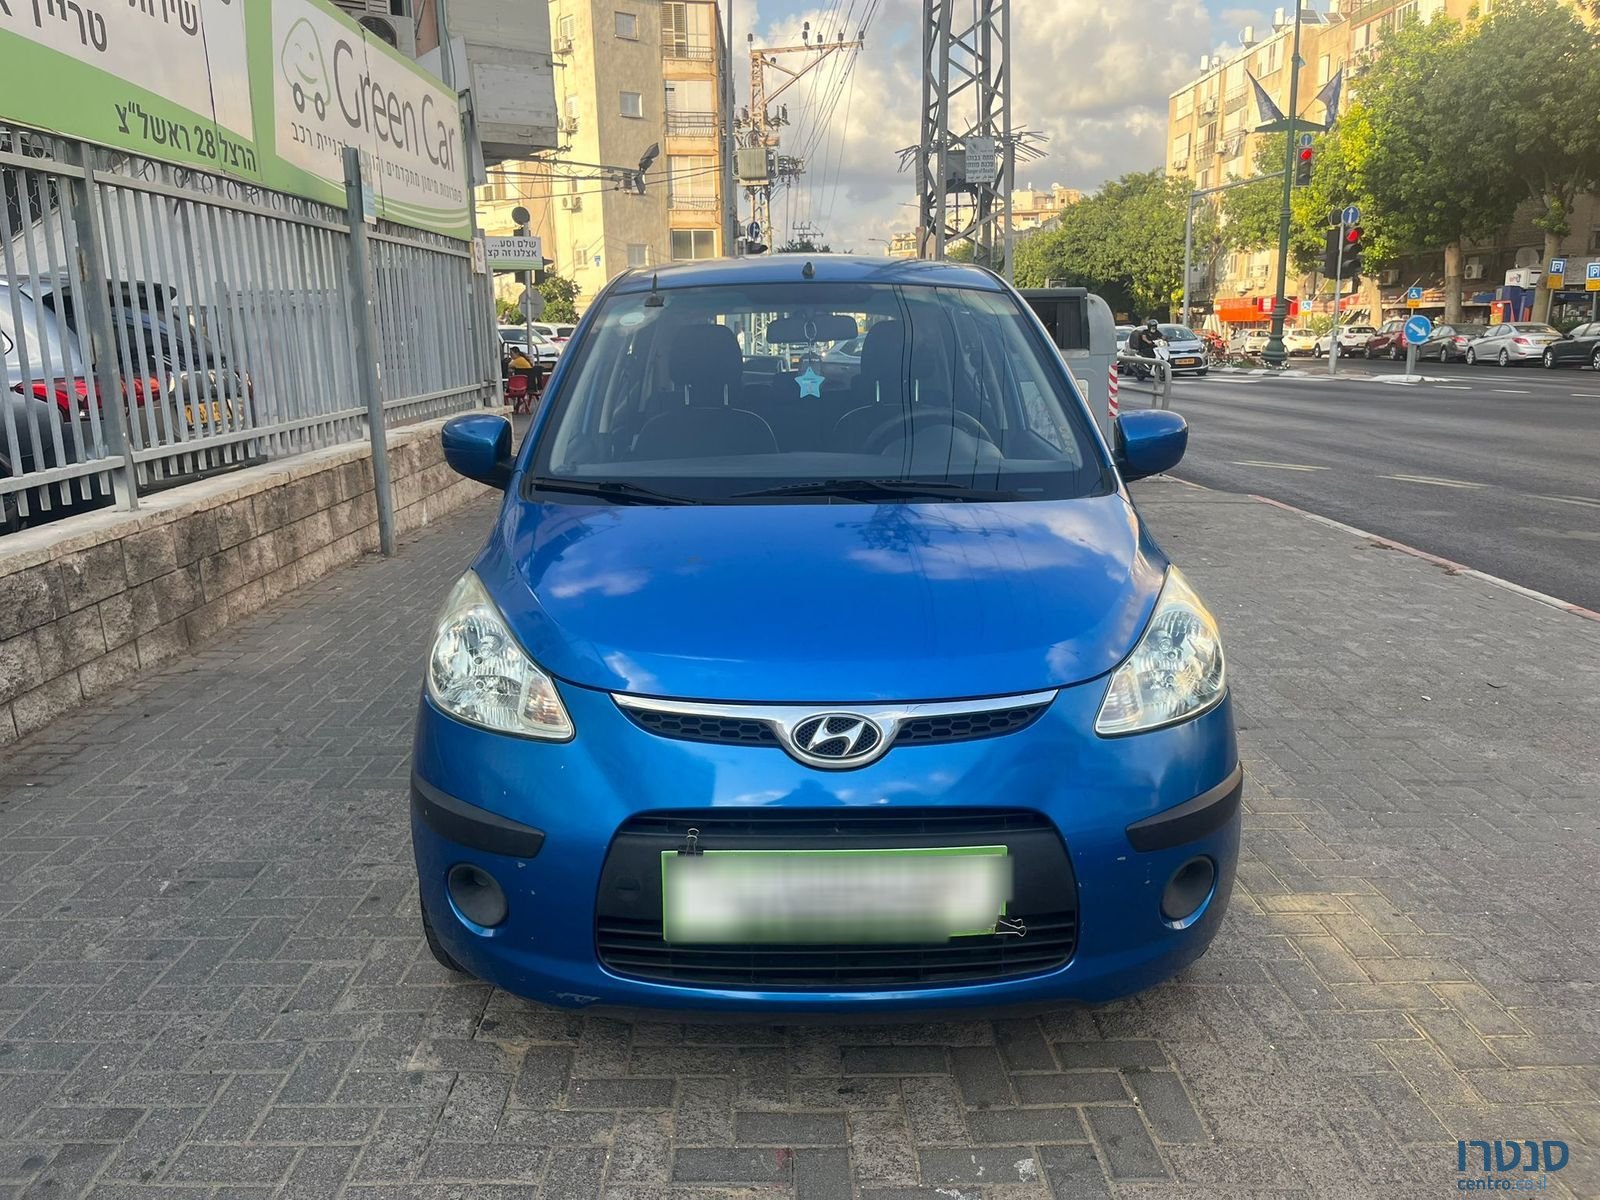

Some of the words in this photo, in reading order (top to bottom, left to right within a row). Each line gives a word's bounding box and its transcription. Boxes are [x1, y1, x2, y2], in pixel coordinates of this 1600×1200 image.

[333, 39, 420, 157] Green
[421, 94, 456, 173] Car
[194, 125, 216, 160] 28
[291, 121, 314, 147] רכב
[218, 131, 257, 173] הרצל
[386, 160, 421, 188] מתקדמים
[501, 249, 512, 257] זה
[513, 248, 538, 258] אצלנו
[517, 239, 537, 249] שלם
